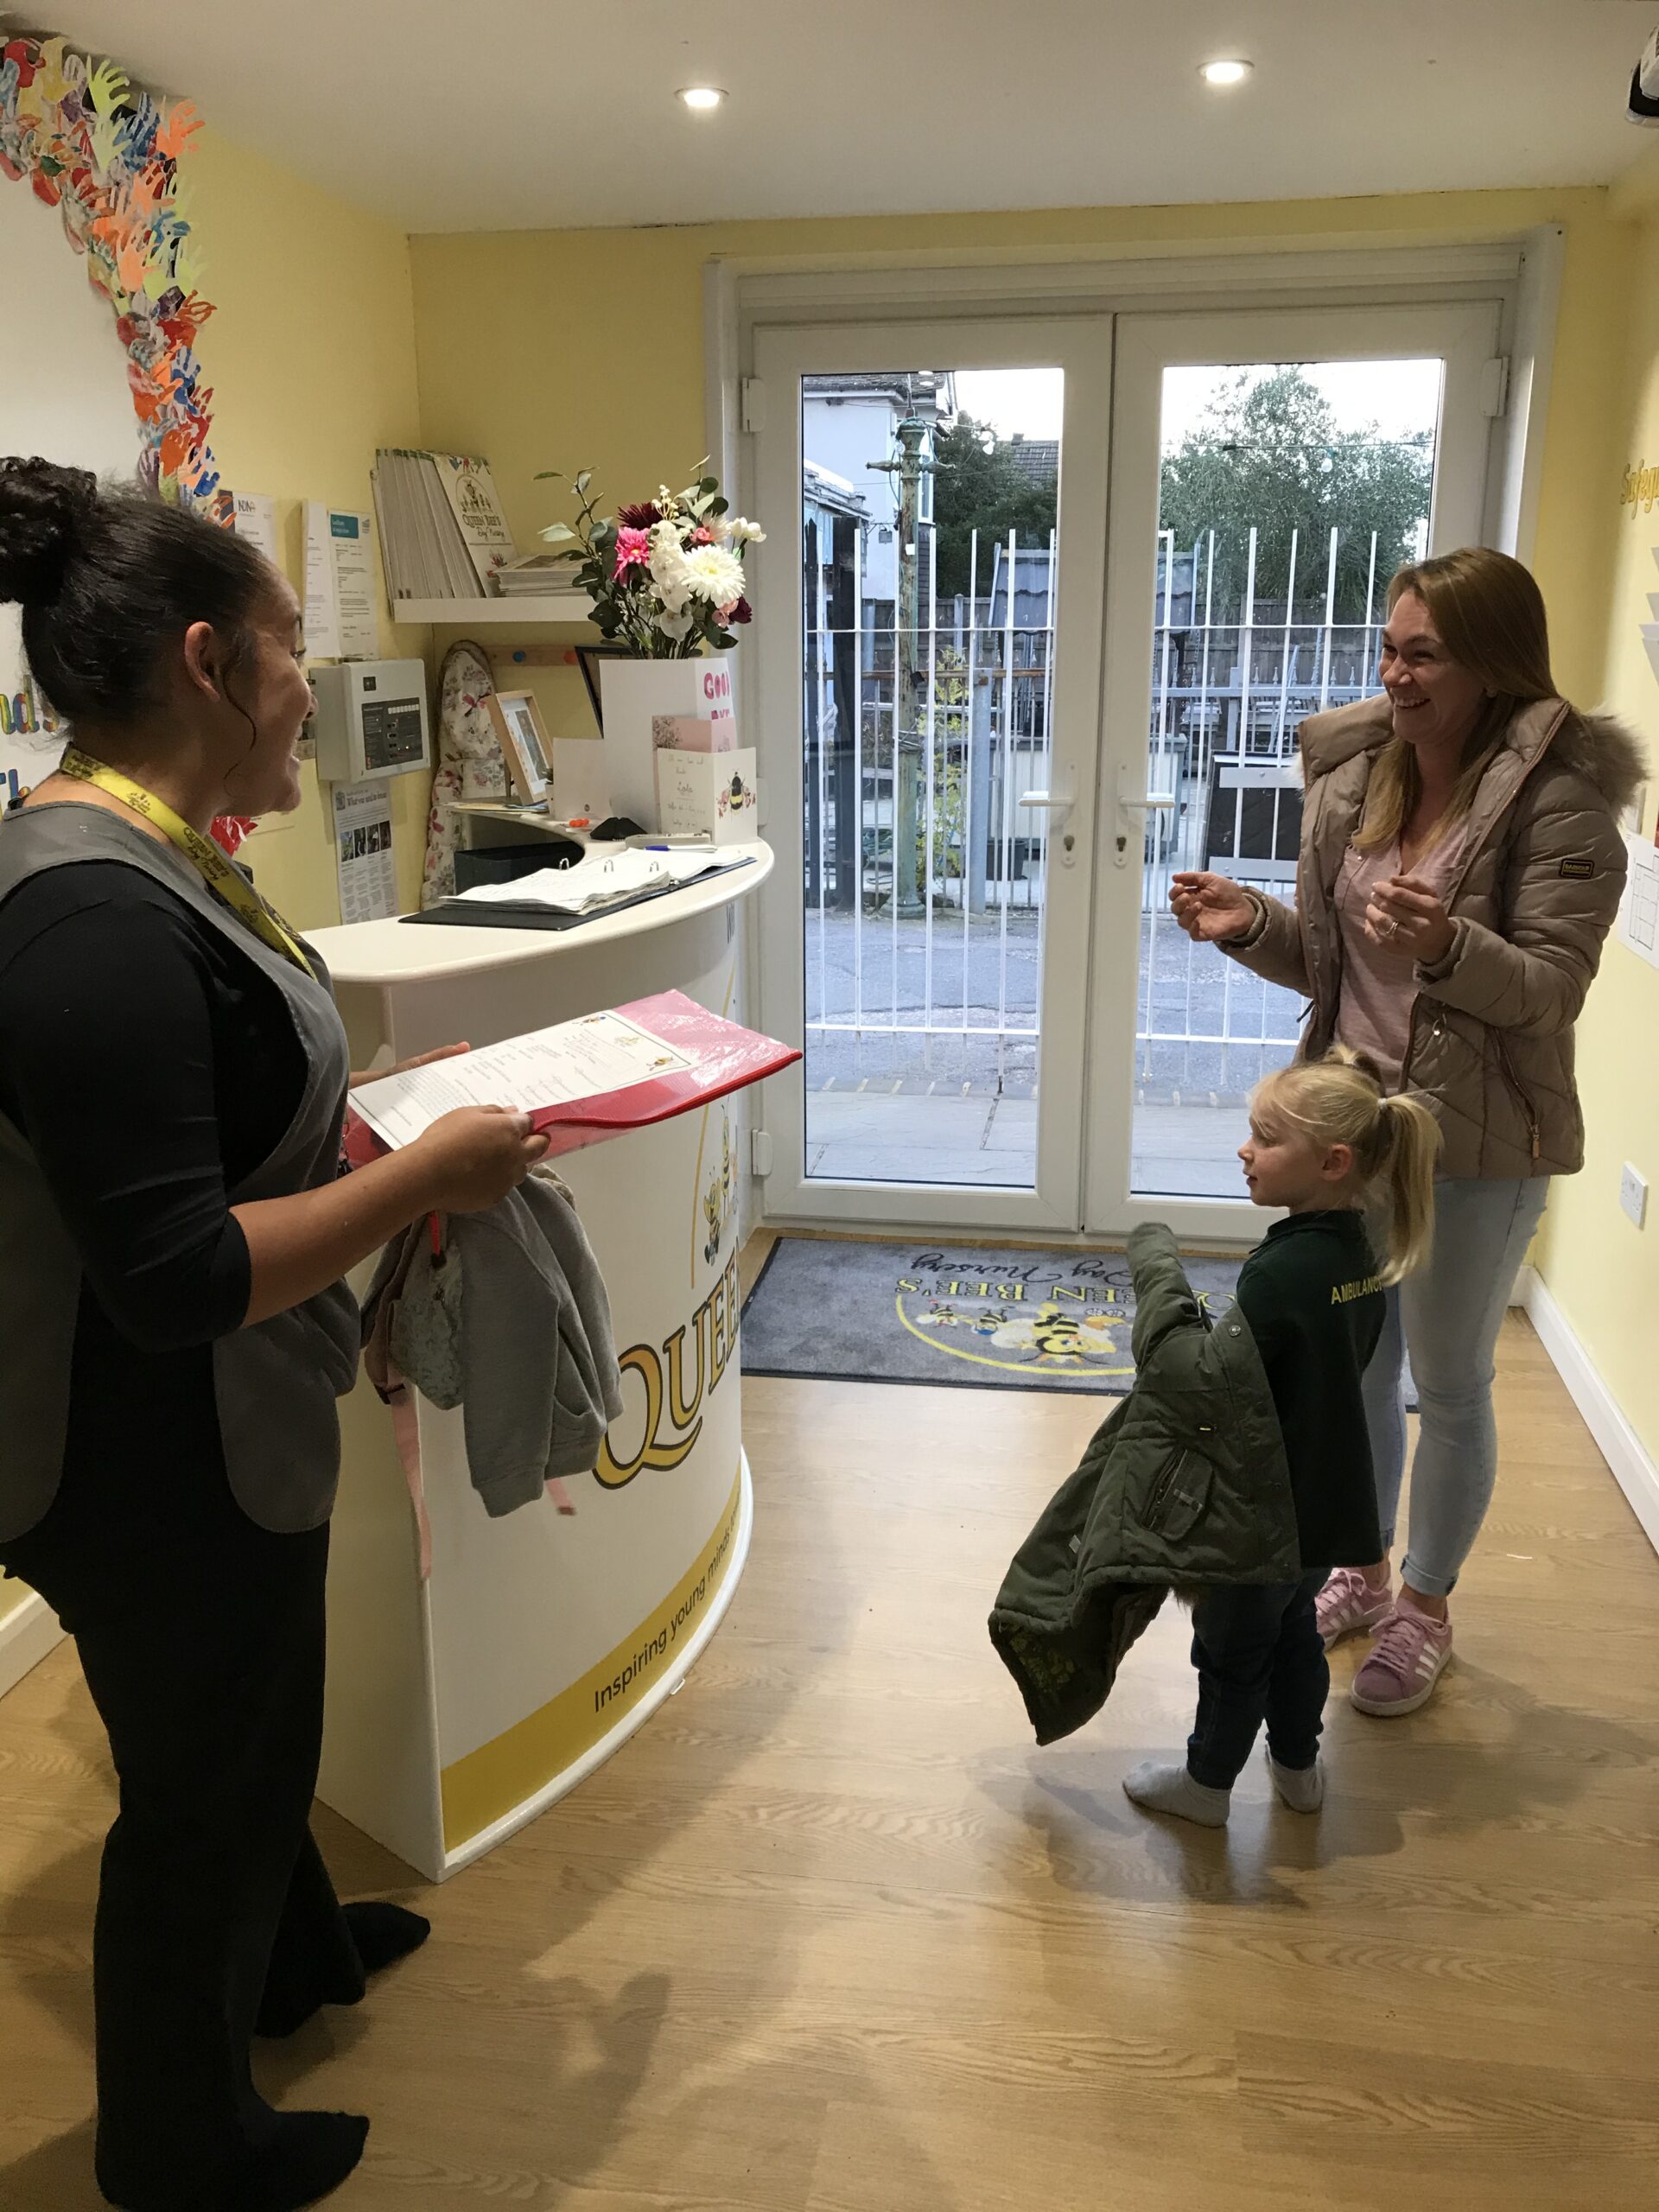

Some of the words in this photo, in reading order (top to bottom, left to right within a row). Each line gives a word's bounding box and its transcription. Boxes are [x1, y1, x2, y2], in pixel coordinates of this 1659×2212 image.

[911, 1252, 1063, 1283] Nursery
[893, 1278, 1028, 1302] BEE'S
[594, 1628, 667, 1713] Inspiring
[671, 1575, 707, 1642] young
[708, 1526, 730, 1583] minds
